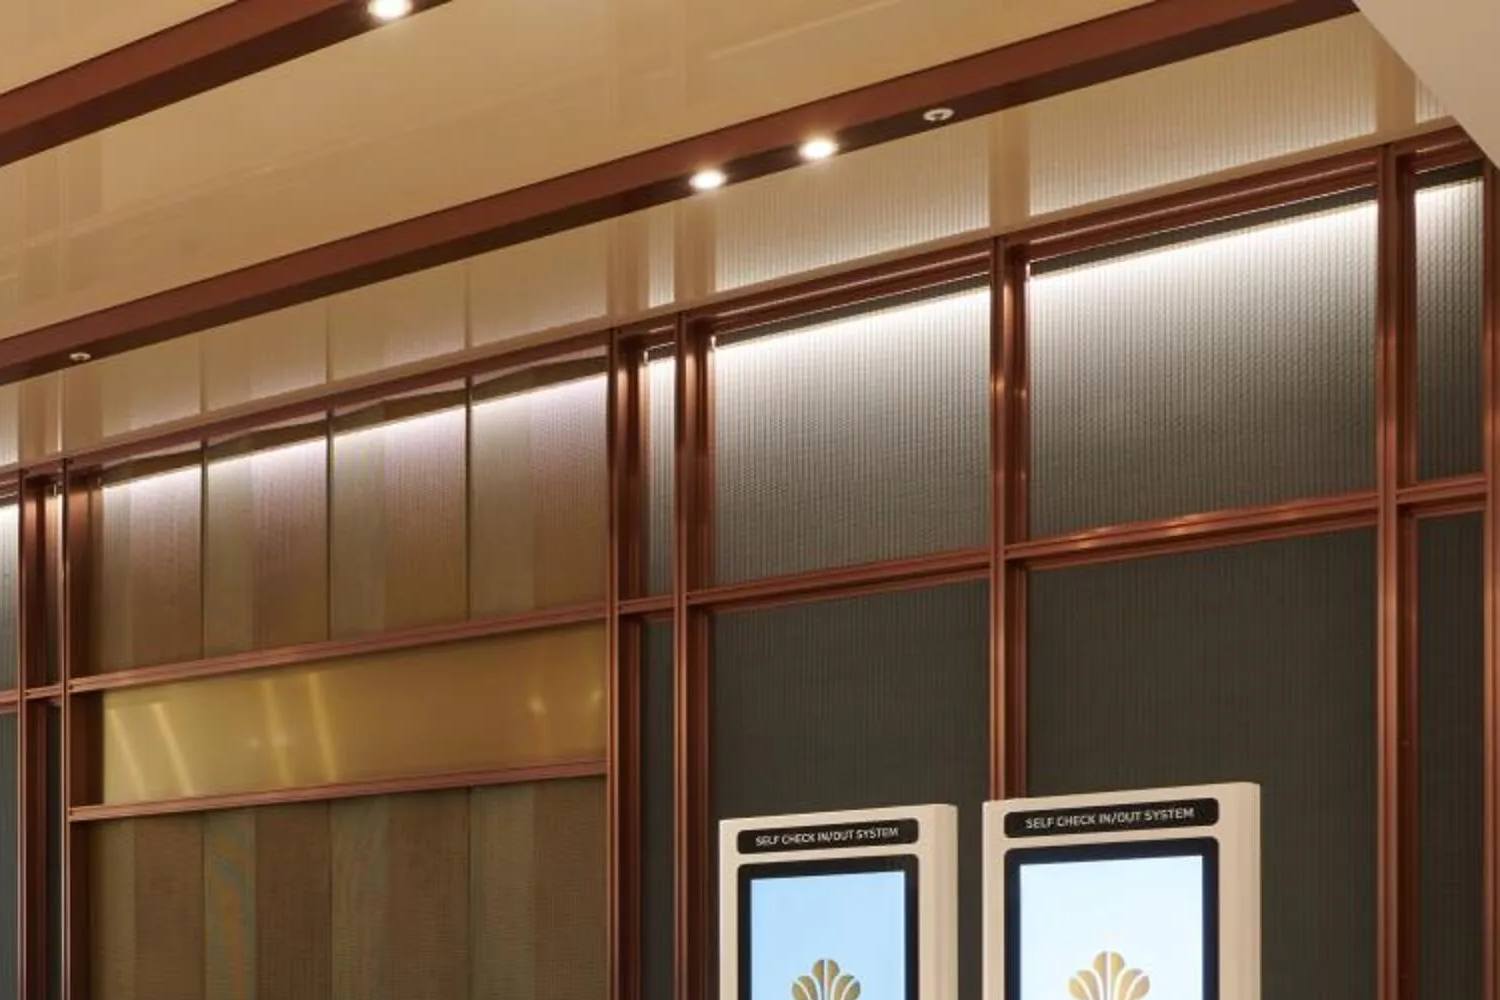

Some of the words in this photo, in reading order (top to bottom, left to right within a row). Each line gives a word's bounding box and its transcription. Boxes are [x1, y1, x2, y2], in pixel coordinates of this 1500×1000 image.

[1025, 817, 1054, 830] SELF
[1056, 814, 1096, 828] CHECK
[1099, 811, 1141, 825] IN/OUT
[1143, 807, 1195, 821] SYSTEM
[755, 834, 778, 847] SELF
[781, 832, 815, 846] CHECK
[817, 829, 854, 843] IN/OUT
[855, 826, 899, 840] SYSTEM
